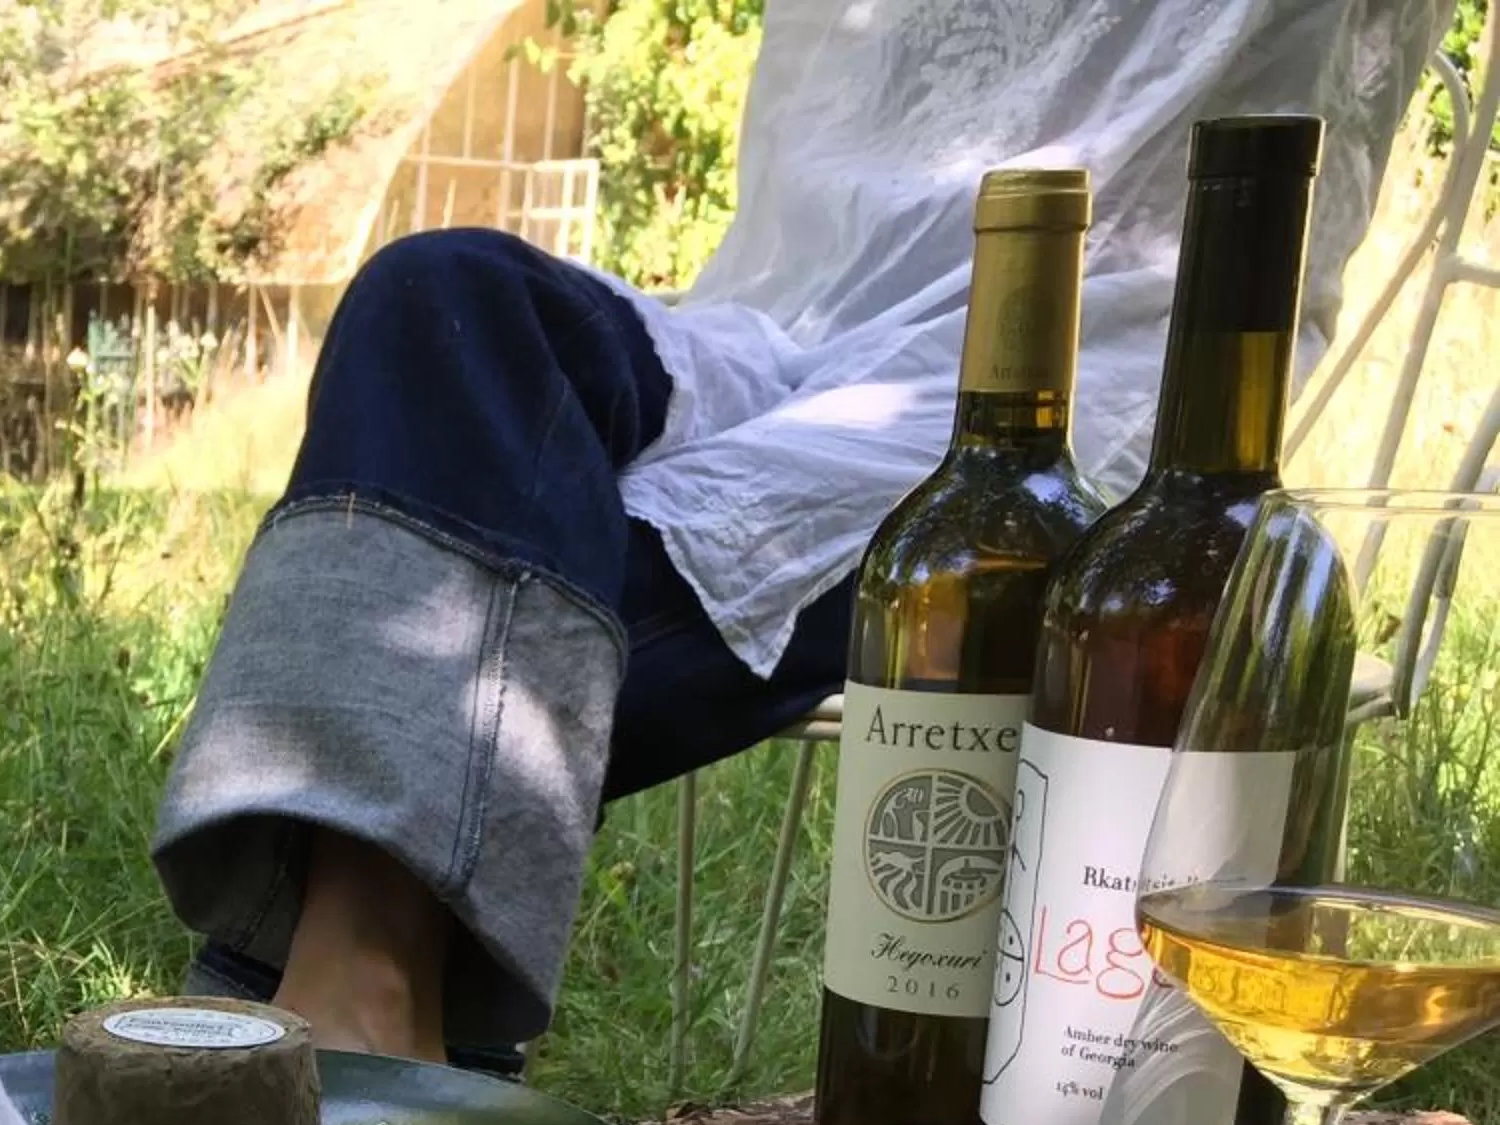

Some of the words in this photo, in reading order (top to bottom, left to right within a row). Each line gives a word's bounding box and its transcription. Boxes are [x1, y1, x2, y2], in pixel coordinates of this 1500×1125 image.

[865, 704, 1019, 753] Arretxe
[870, 932, 989, 971] Hegoxuri
[886, 975, 961, 1000] 2016
[1064, 1025, 1110, 1045] Amber
[1113, 1033, 1136, 1053] dry
[1140, 1038, 1180, 1053] wine
[1061, 1044, 1075, 1057] of
[1079, 1046, 1137, 1071] Georgia
[1083, 1087, 1104, 1100] vol
